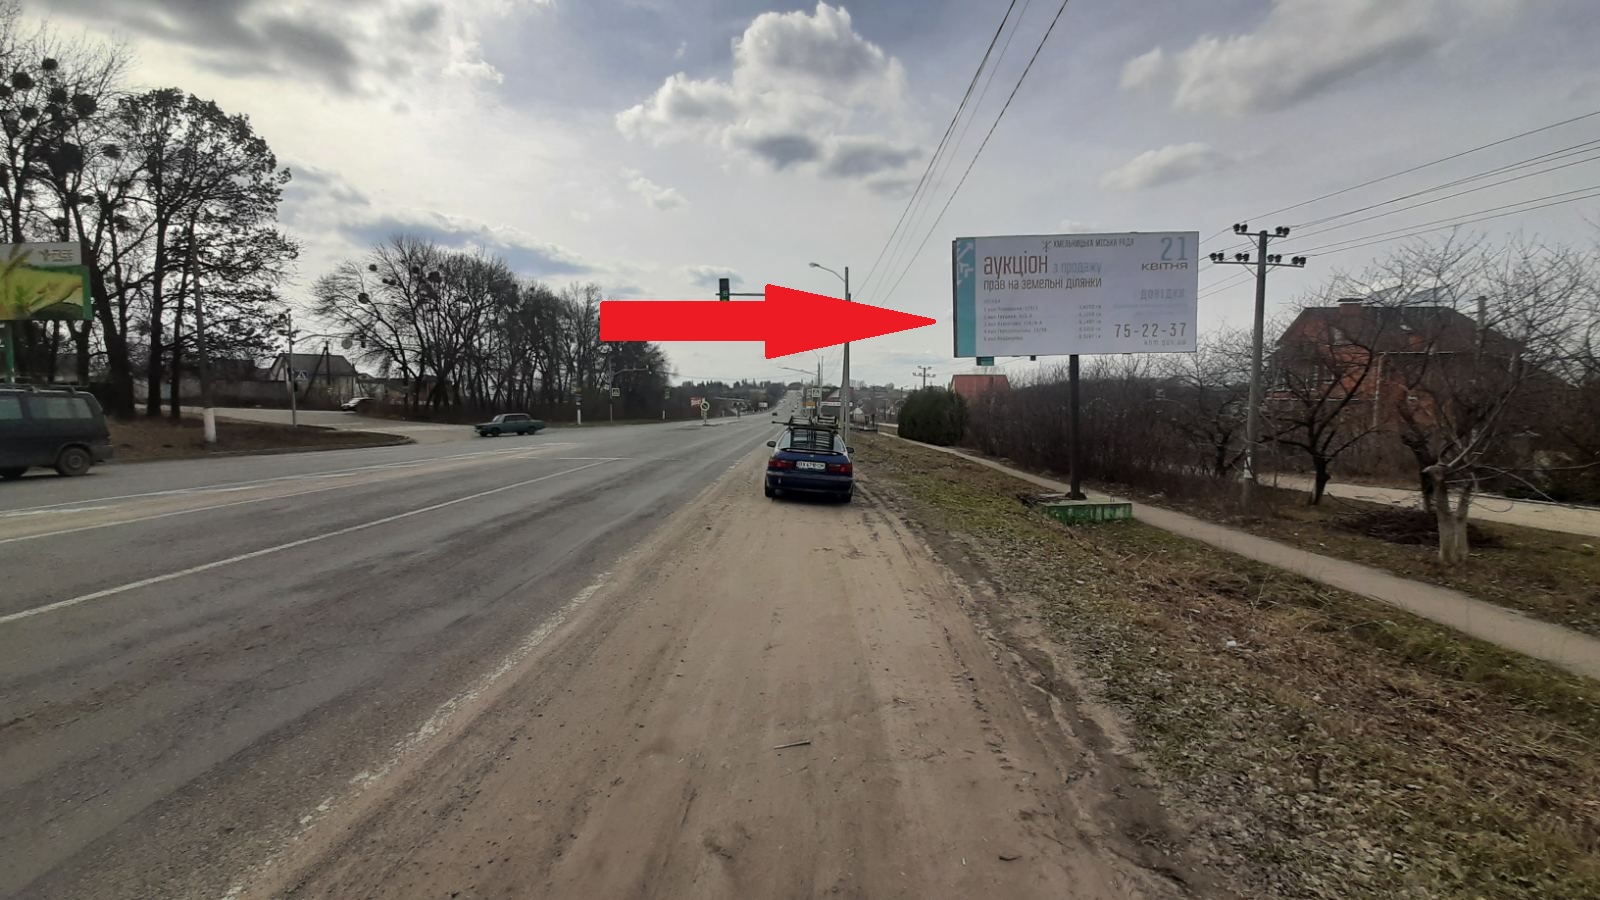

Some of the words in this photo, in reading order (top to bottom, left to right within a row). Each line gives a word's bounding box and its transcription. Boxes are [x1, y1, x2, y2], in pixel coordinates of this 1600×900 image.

[1160, 236, 1188, 261] 21
[983, 250, 1048, 280] аукціон
[1061, 261, 1103, 275] продажу
[983, 278, 1006, 291] прав
[1008, 279, 1019, 290] на
[1021, 277, 1063, 290] земельні
[1065, 276, 1102, 290] ділянки
[1114, 322, 1187, 338] 75-22-37
